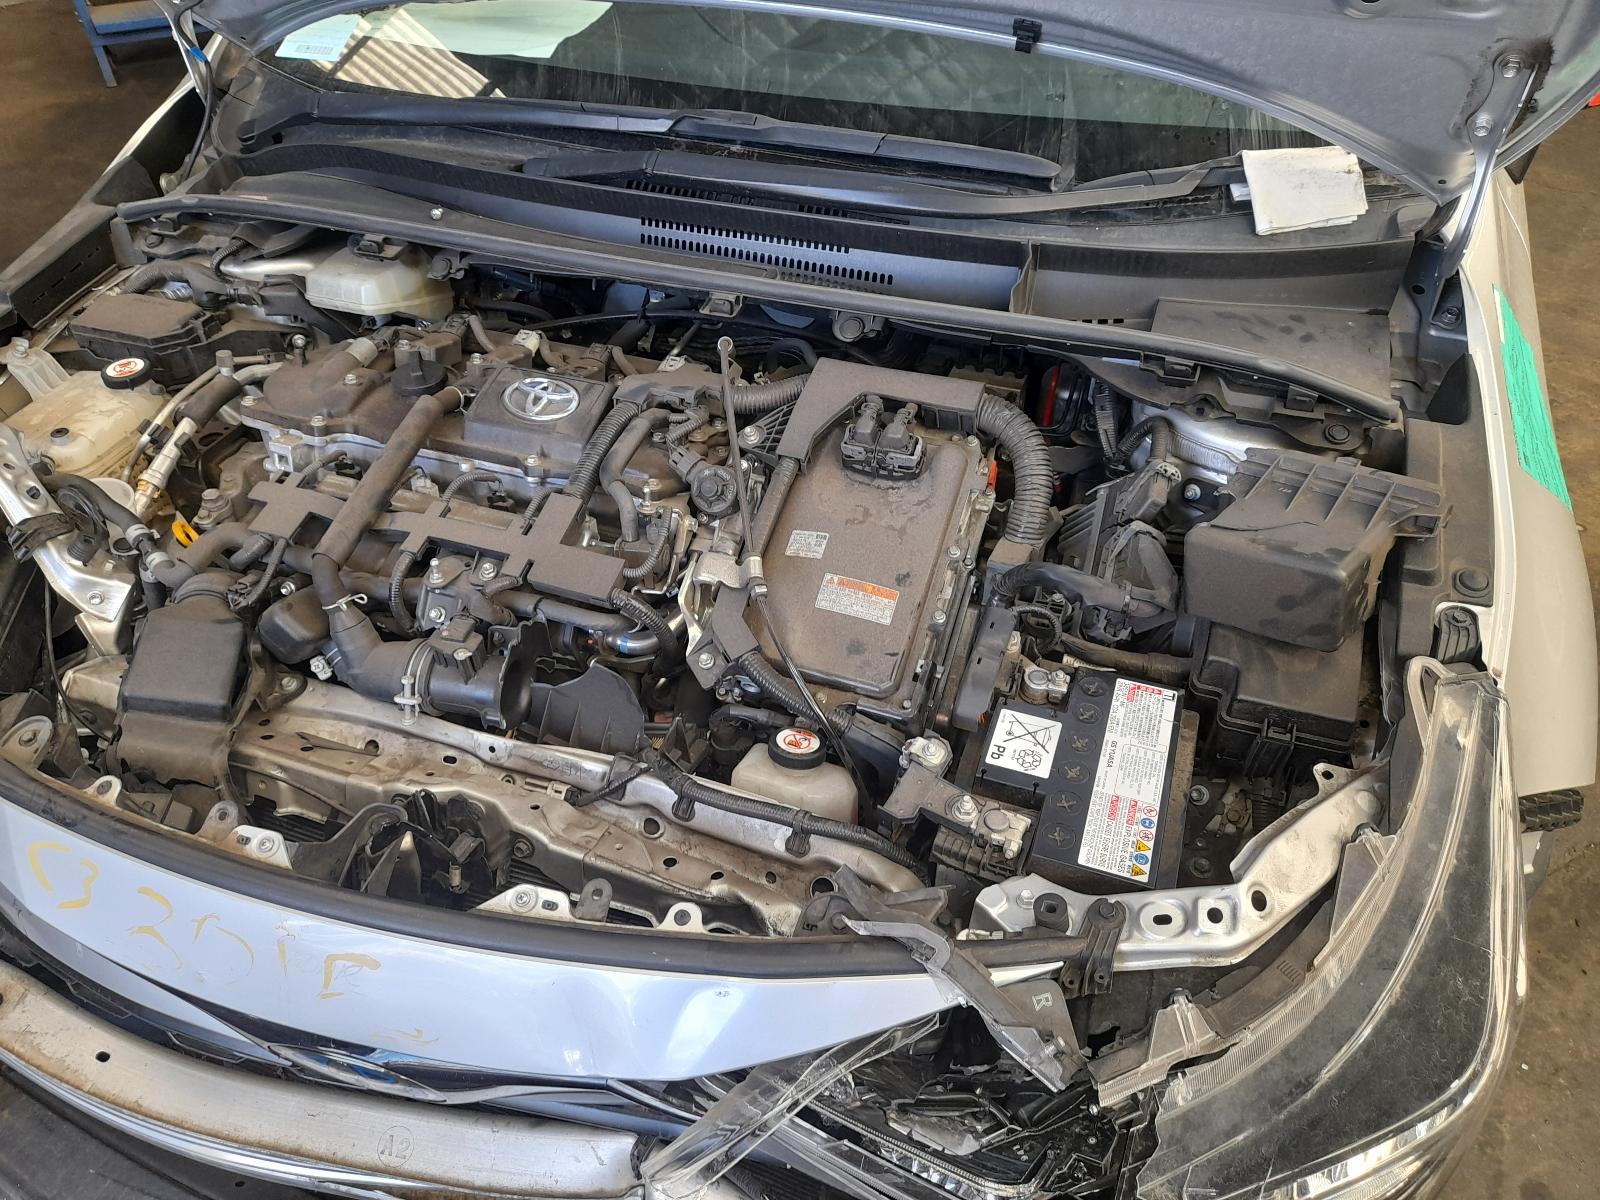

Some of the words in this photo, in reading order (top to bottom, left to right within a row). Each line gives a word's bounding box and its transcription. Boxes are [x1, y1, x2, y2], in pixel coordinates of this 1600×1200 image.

[990, 744, 1006, 760] Pb
[1111, 740, 1118, 748] GS
[1106, 748, 1116, 768] YUASA
[1121, 825, 1132, 854] EXPLOSIVE
[1118, 854, 1127, 874] GASES
[1032, 992, 1052, 1012] R
[380, 1134, 410, 1160] A2
